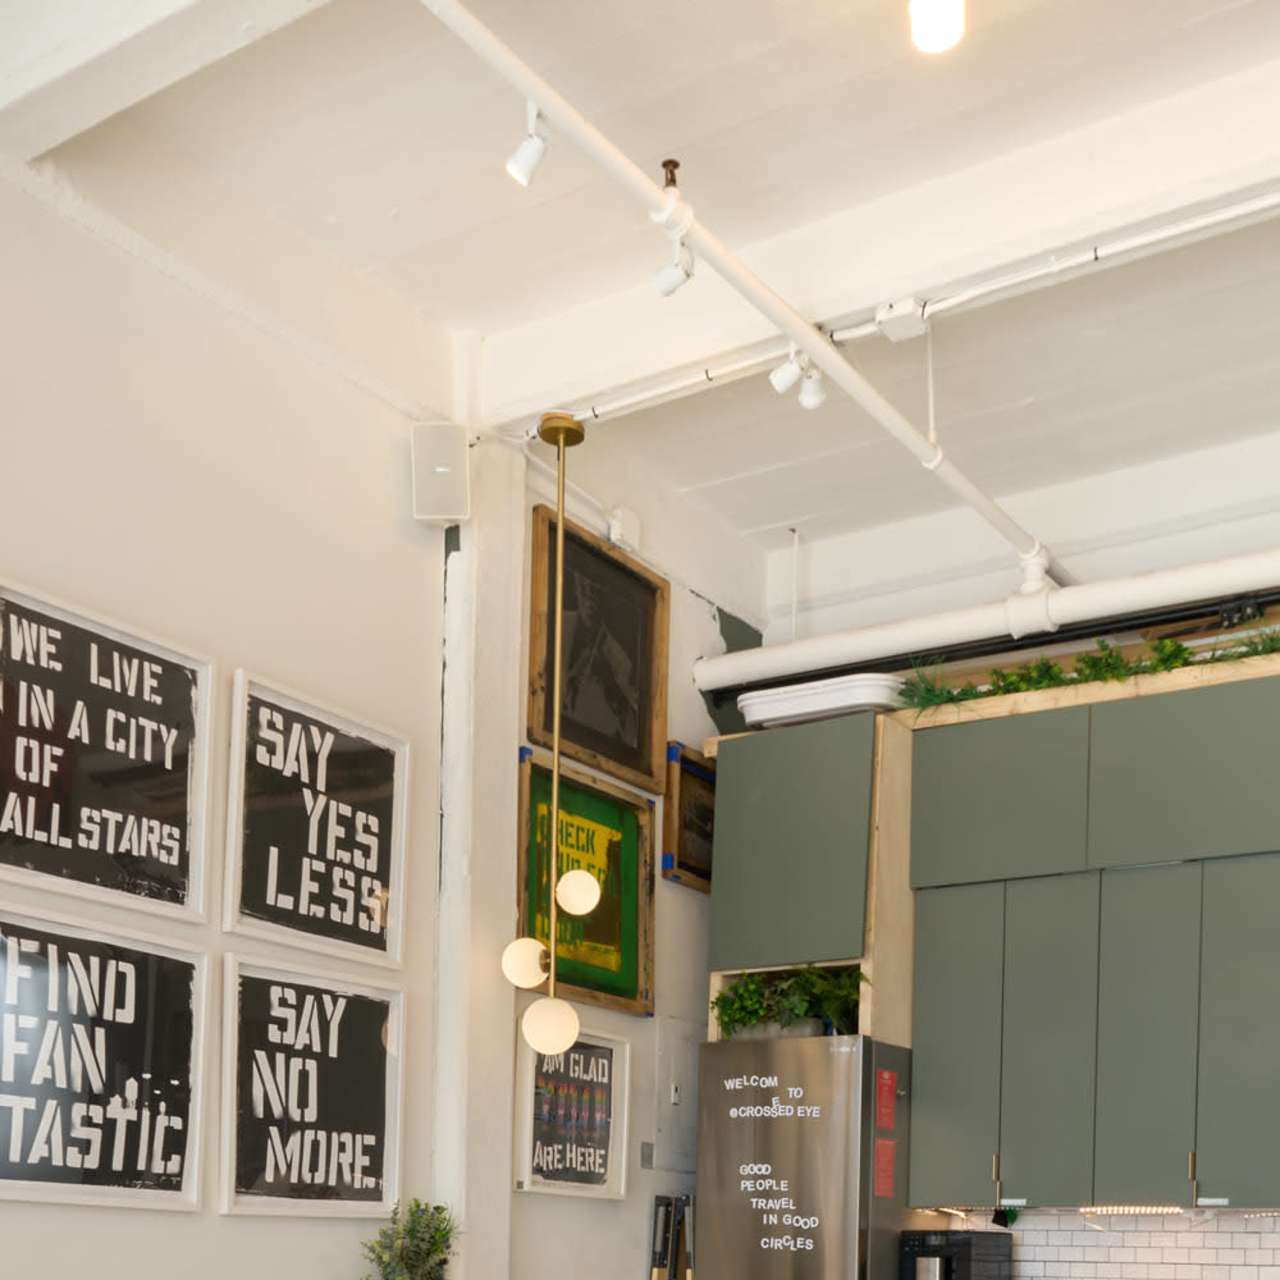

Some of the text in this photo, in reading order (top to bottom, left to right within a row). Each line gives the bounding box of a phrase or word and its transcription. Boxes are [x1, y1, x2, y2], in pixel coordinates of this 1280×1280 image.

[9, 613, 163, 706] WE LIVE
[18, 681, 178, 771] IN A CITY
[255, 705, 335, 793] SAY
[14, 736, 64, 788] OF
[302, 786, 380, 873] YES
[266, 845, 382, 934] LESS
[4, 936, 136, 1024] FIND
[268, 985, 347, 1059] SAY
[0, 1013, 106, 1095] FAN
[570, 1052, 609, 1083] GLAD
[252, 1049, 318, 1123] NO
[787, 1087, 804, 1098] TO
[796, 1106, 820, 1118] EYE
[265, 1125, 376, 1189] MORE
[533, 1140, 606, 1174] ARE HERE
[740, 1163, 772, 1176] GOOD
[740, 1178, 789, 1191] PEOPLE
[750, 1198, 796, 1210] TRAVEL
[763, 1214, 819, 1230] IN GOOD
[760, 1235, 814, 1251] CIRCLES
